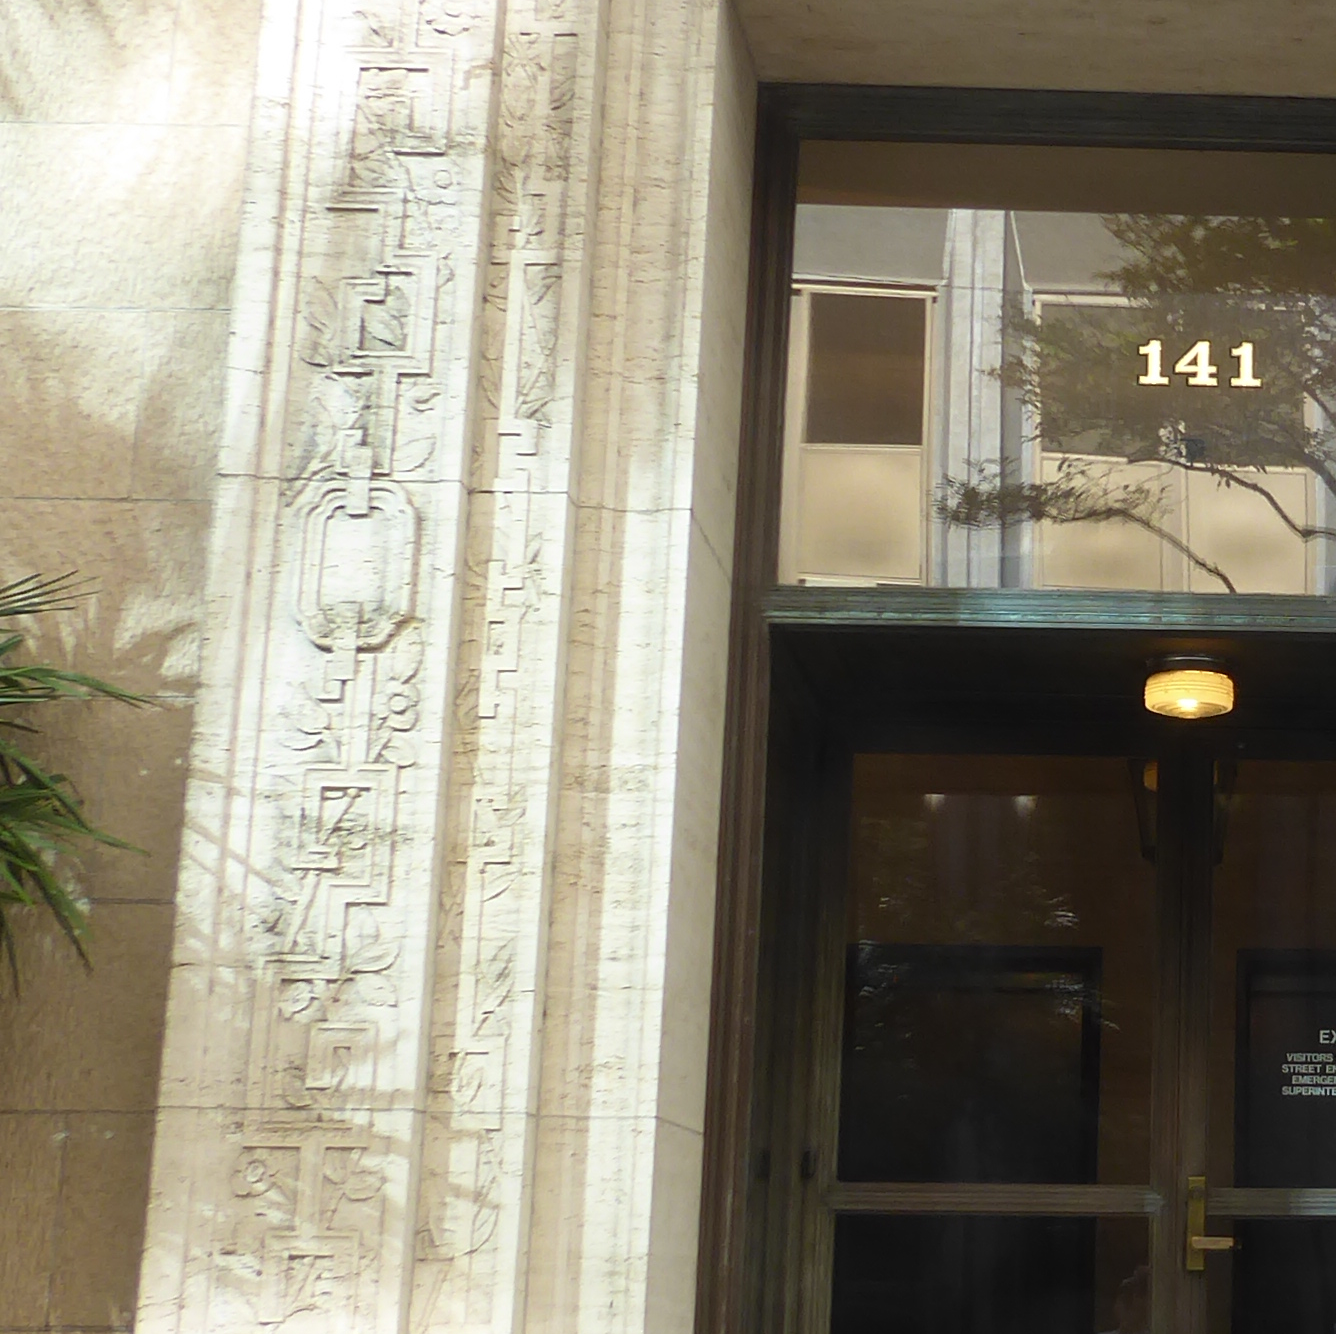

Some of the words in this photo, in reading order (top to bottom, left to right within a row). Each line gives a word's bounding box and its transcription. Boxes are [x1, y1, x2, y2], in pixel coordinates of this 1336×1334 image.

[1137, 339, 1262, 387] 141
[1286, 1053, 1334, 1062] VISITORS
[1281, 1064, 1322, 1073] STREET
